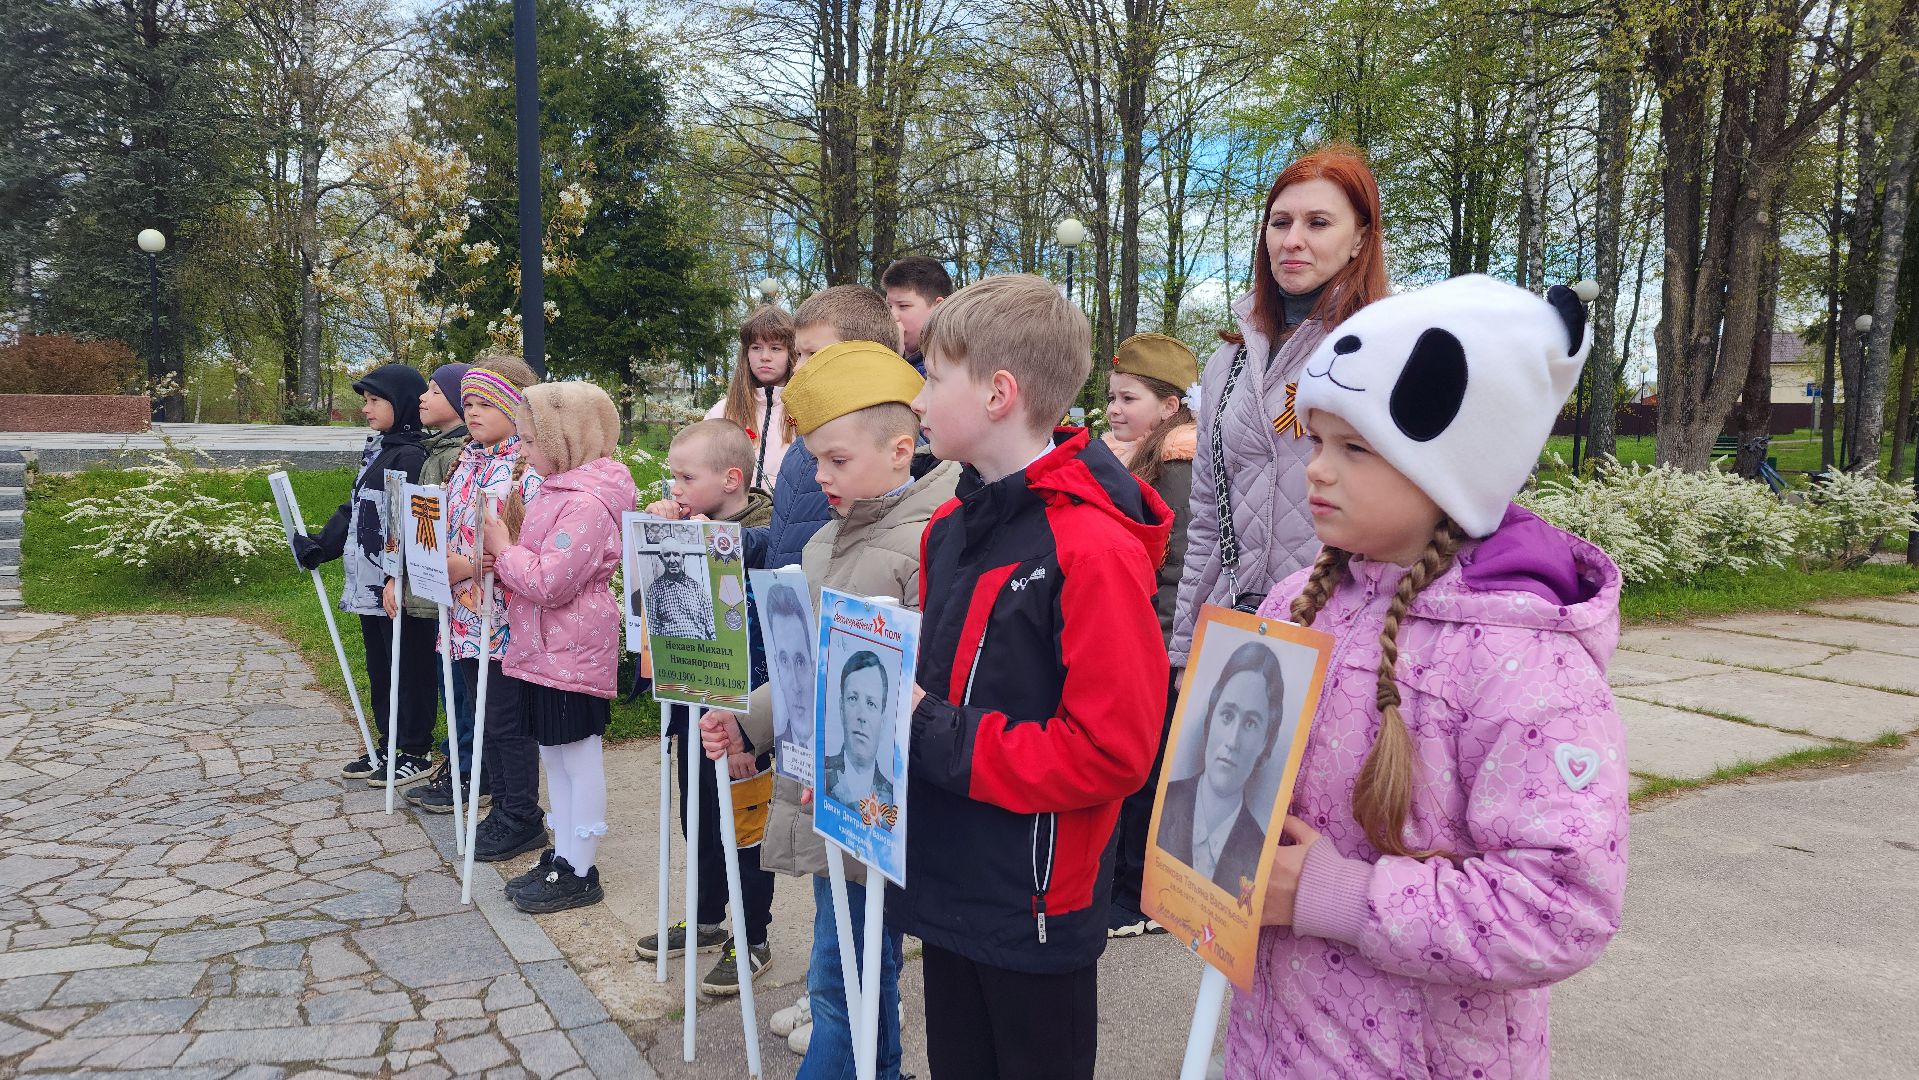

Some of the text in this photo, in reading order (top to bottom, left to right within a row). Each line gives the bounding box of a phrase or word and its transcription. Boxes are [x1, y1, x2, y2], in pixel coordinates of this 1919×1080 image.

[665, 640, 733, 656] Нехаев Михаил
[670, 654, 730, 670] Никанорович
[704, 675, 746, 690] 21.04.1987
[1183, 876, 1209, 901] Татьяна
[1209, 893, 1249, 929] Васильевна
